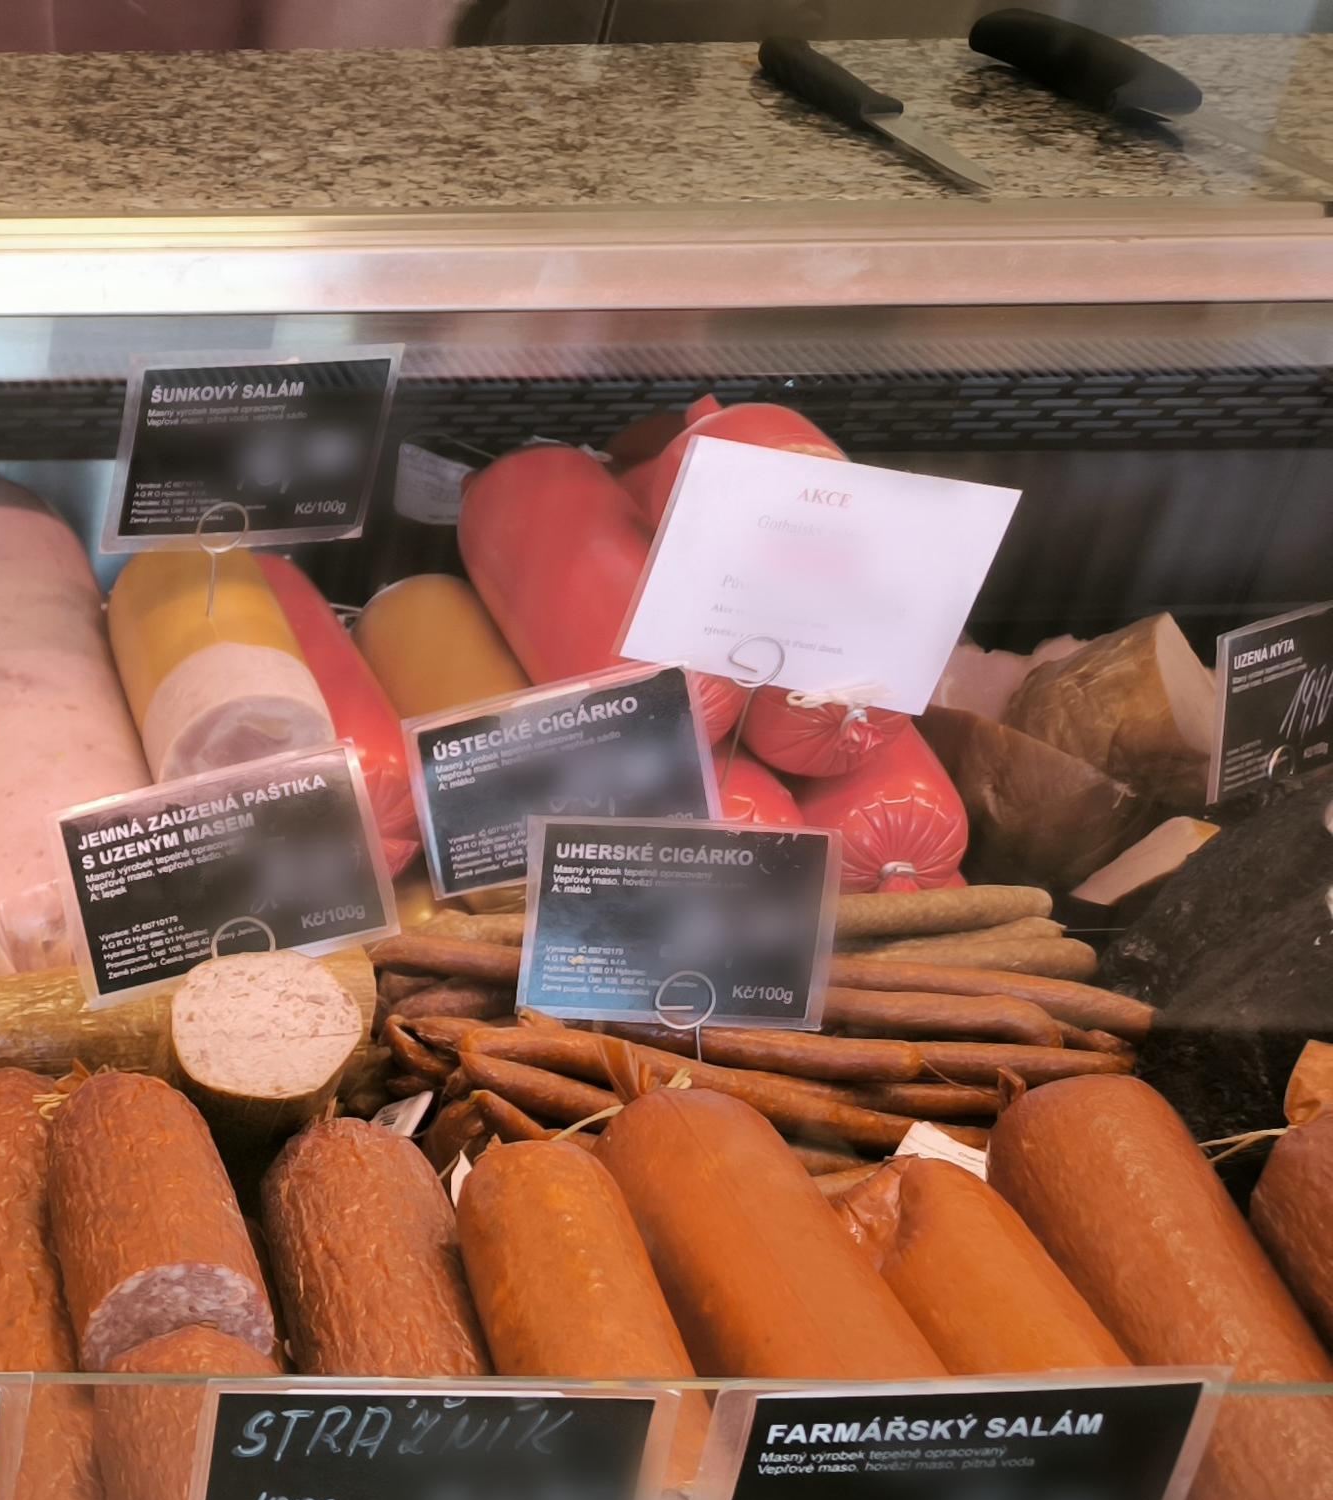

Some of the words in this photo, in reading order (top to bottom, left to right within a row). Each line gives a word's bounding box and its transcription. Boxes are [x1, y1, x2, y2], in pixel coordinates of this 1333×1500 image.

[150, 382, 238, 403] ŠUNKOVÝ
[242, 379, 304, 399] SALÁM
[796, 488, 853, 509] AKCE
[1233, 647, 1268, 671] UZENÁ
[1269, 638, 1295, 659] KÝTA
[432, 721, 533, 762] ÚSTECKÉ
[537, 696, 638, 734] CIGÁRKO
[78, 820, 145, 851] JEMNÁ
[146, 794, 238, 831] ZAUZENÁ
[242, 774, 327, 808] PAŠTIKA
[81, 856, 95, 871] S
[99, 832, 179, 866] UZENÝM
[183, 812, 255, 844] MASEM
[555, 842, 654, 862] UHERSKÉ
[658, 846, 755, 866] CIGÁRKO
[300, 903, 367, 930] Kč/100g
[732, 984, 794, 1004] Kč/100g
[766, 1413, 979, 1445] FARMÁŘSKÝ
[984, 1410, 1104, 1439] SALÁM
[757, 1462, 815, 1476] Vepřové
[759, 1451, 807, 1464] Masný
[810, 1450, 865, 1462] výrobek
